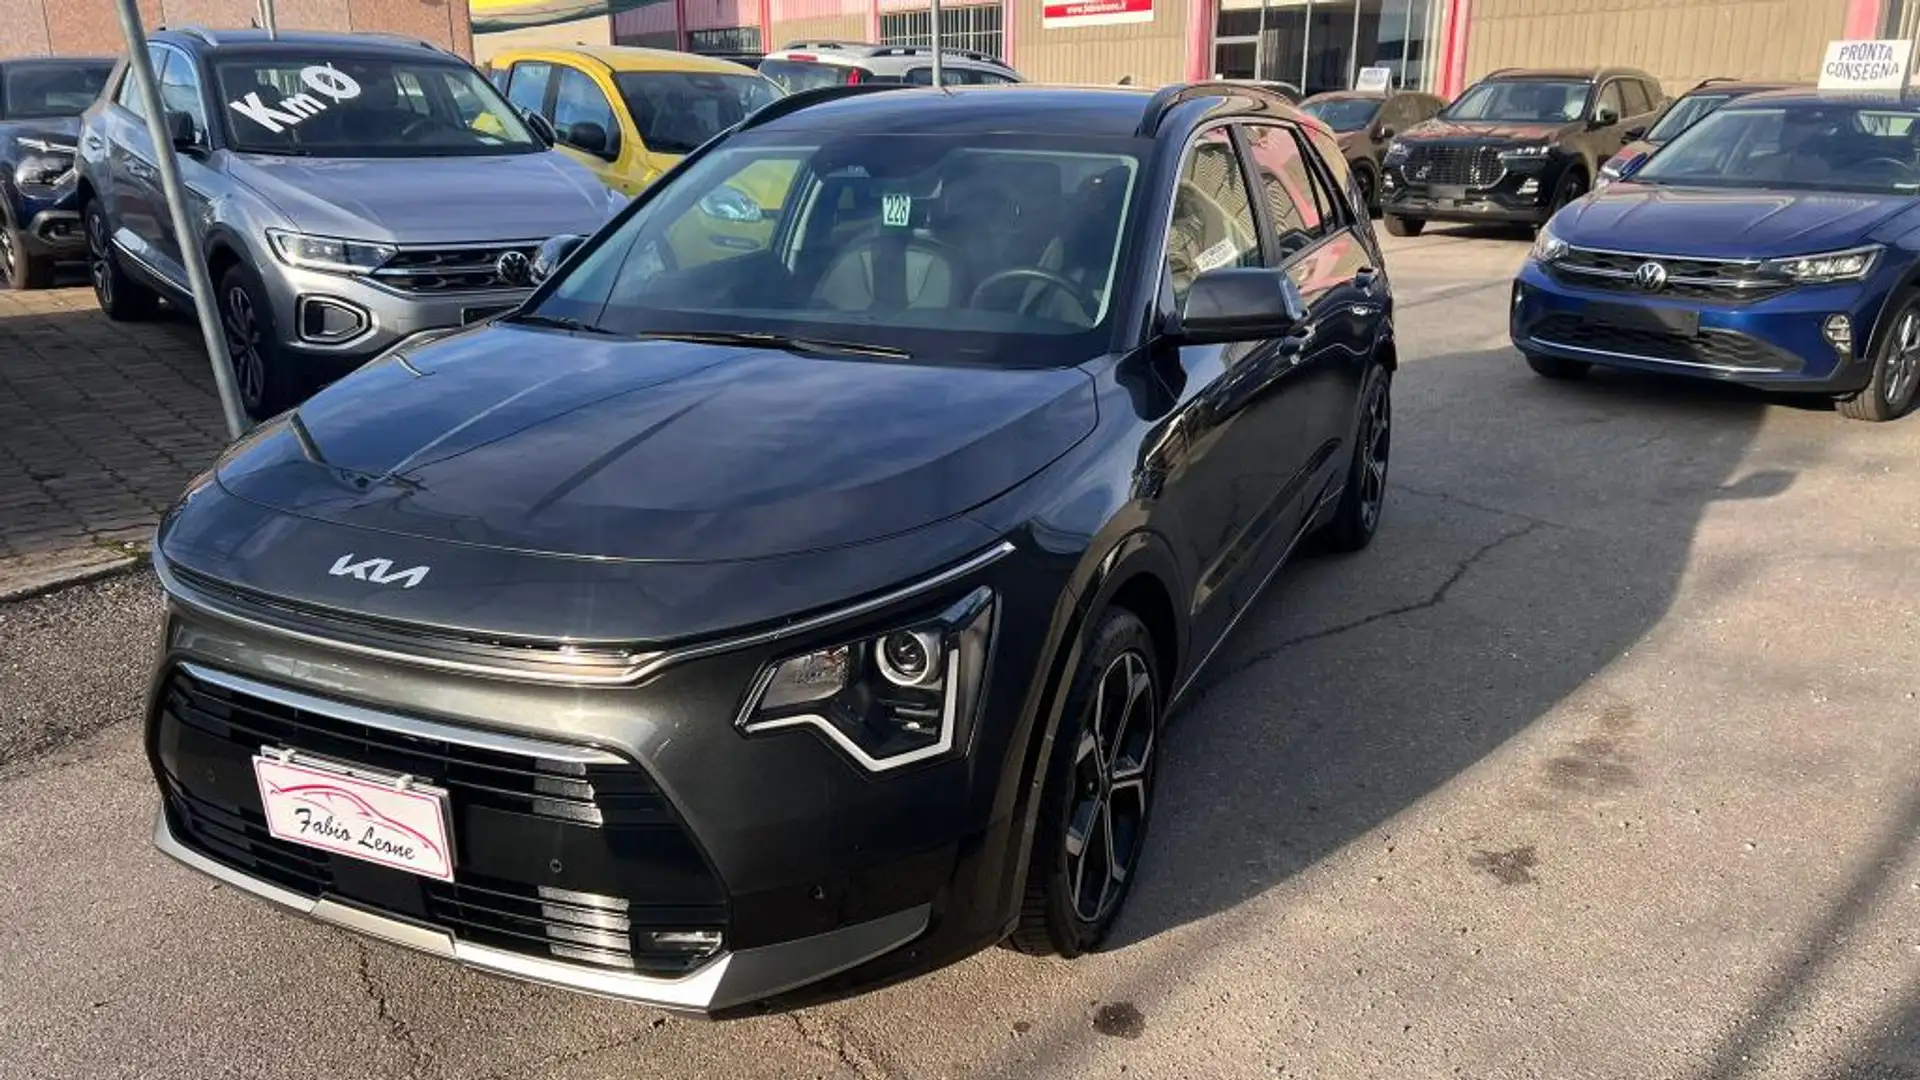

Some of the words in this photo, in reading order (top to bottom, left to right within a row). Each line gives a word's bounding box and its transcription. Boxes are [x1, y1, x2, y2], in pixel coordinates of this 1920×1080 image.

[1838, 43, 1894, 61] PRONTA
[1826, 62, 1899, 81] CONSEGNA
[328, 553, 431, 589] KIA
[295, 808, 351, 841] Fabio
[358, 826, 416, 861] Leone
